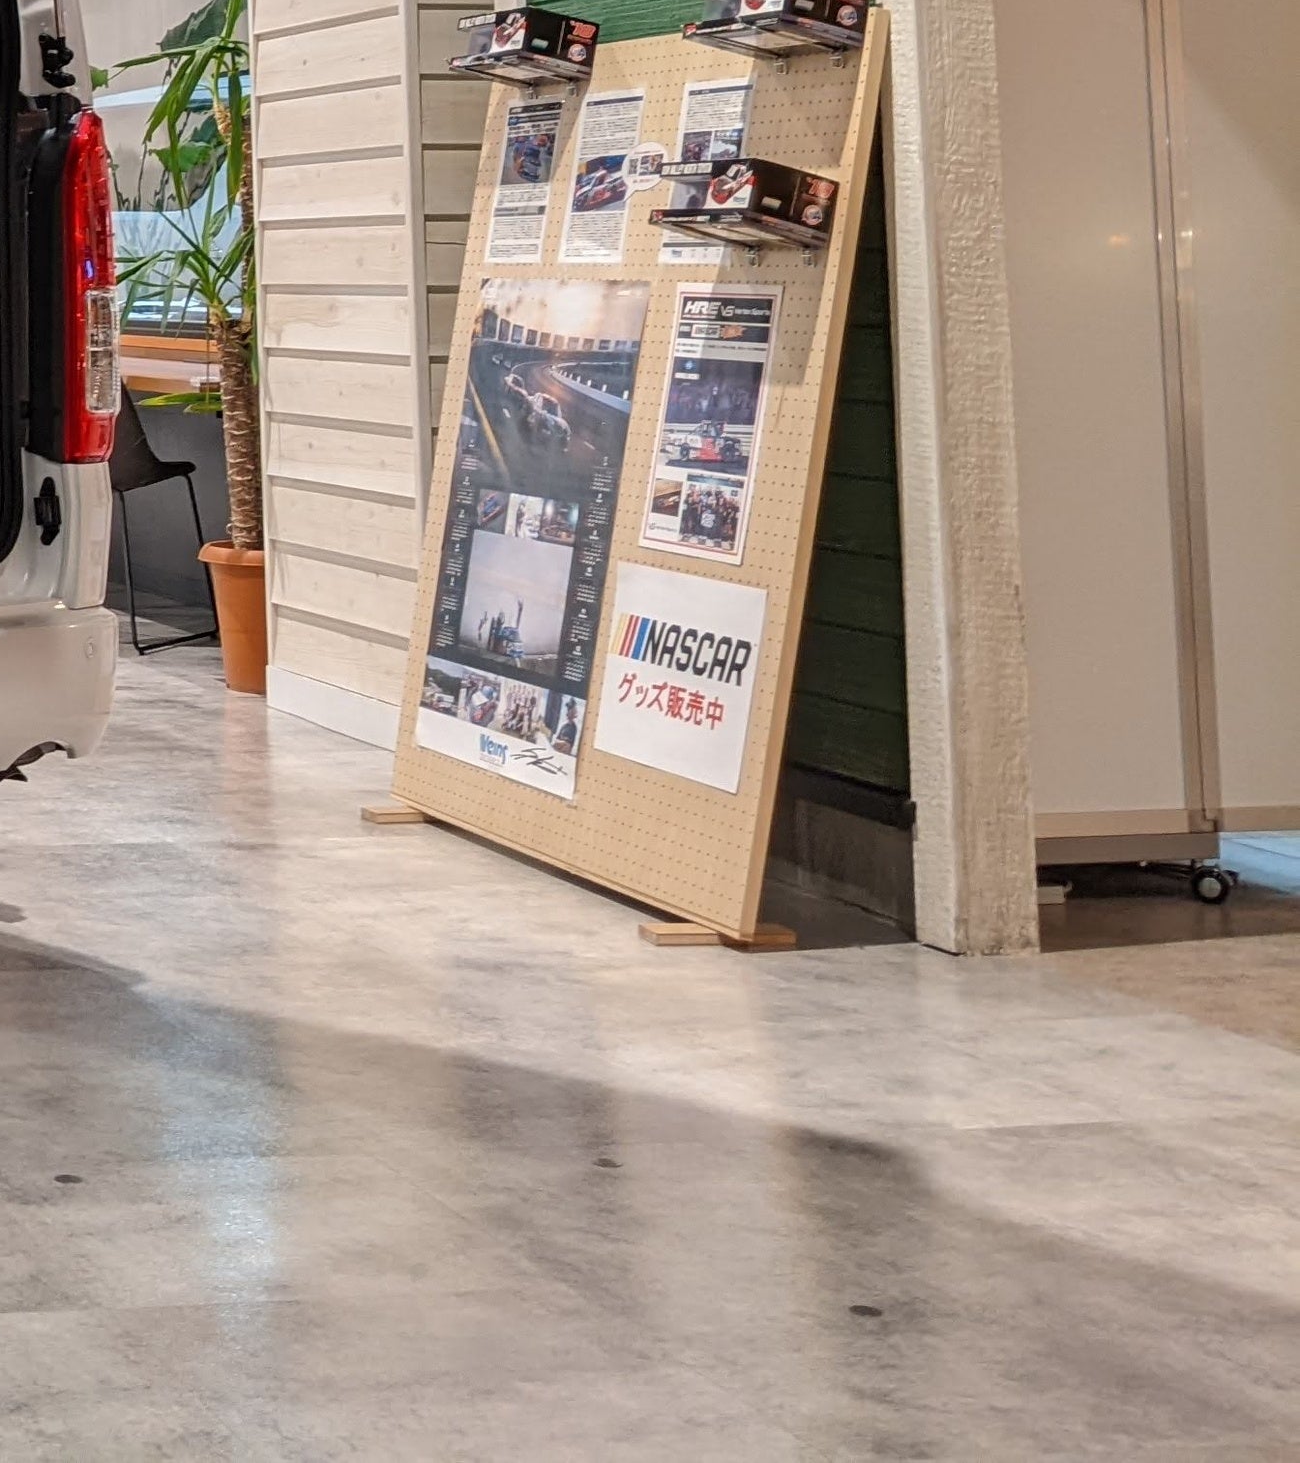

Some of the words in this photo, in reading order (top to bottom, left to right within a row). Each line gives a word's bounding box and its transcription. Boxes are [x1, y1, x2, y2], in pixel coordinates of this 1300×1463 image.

[641, 619, 753, 687] NASCAR
[618, 672, 726, 731] グッズ販売中
